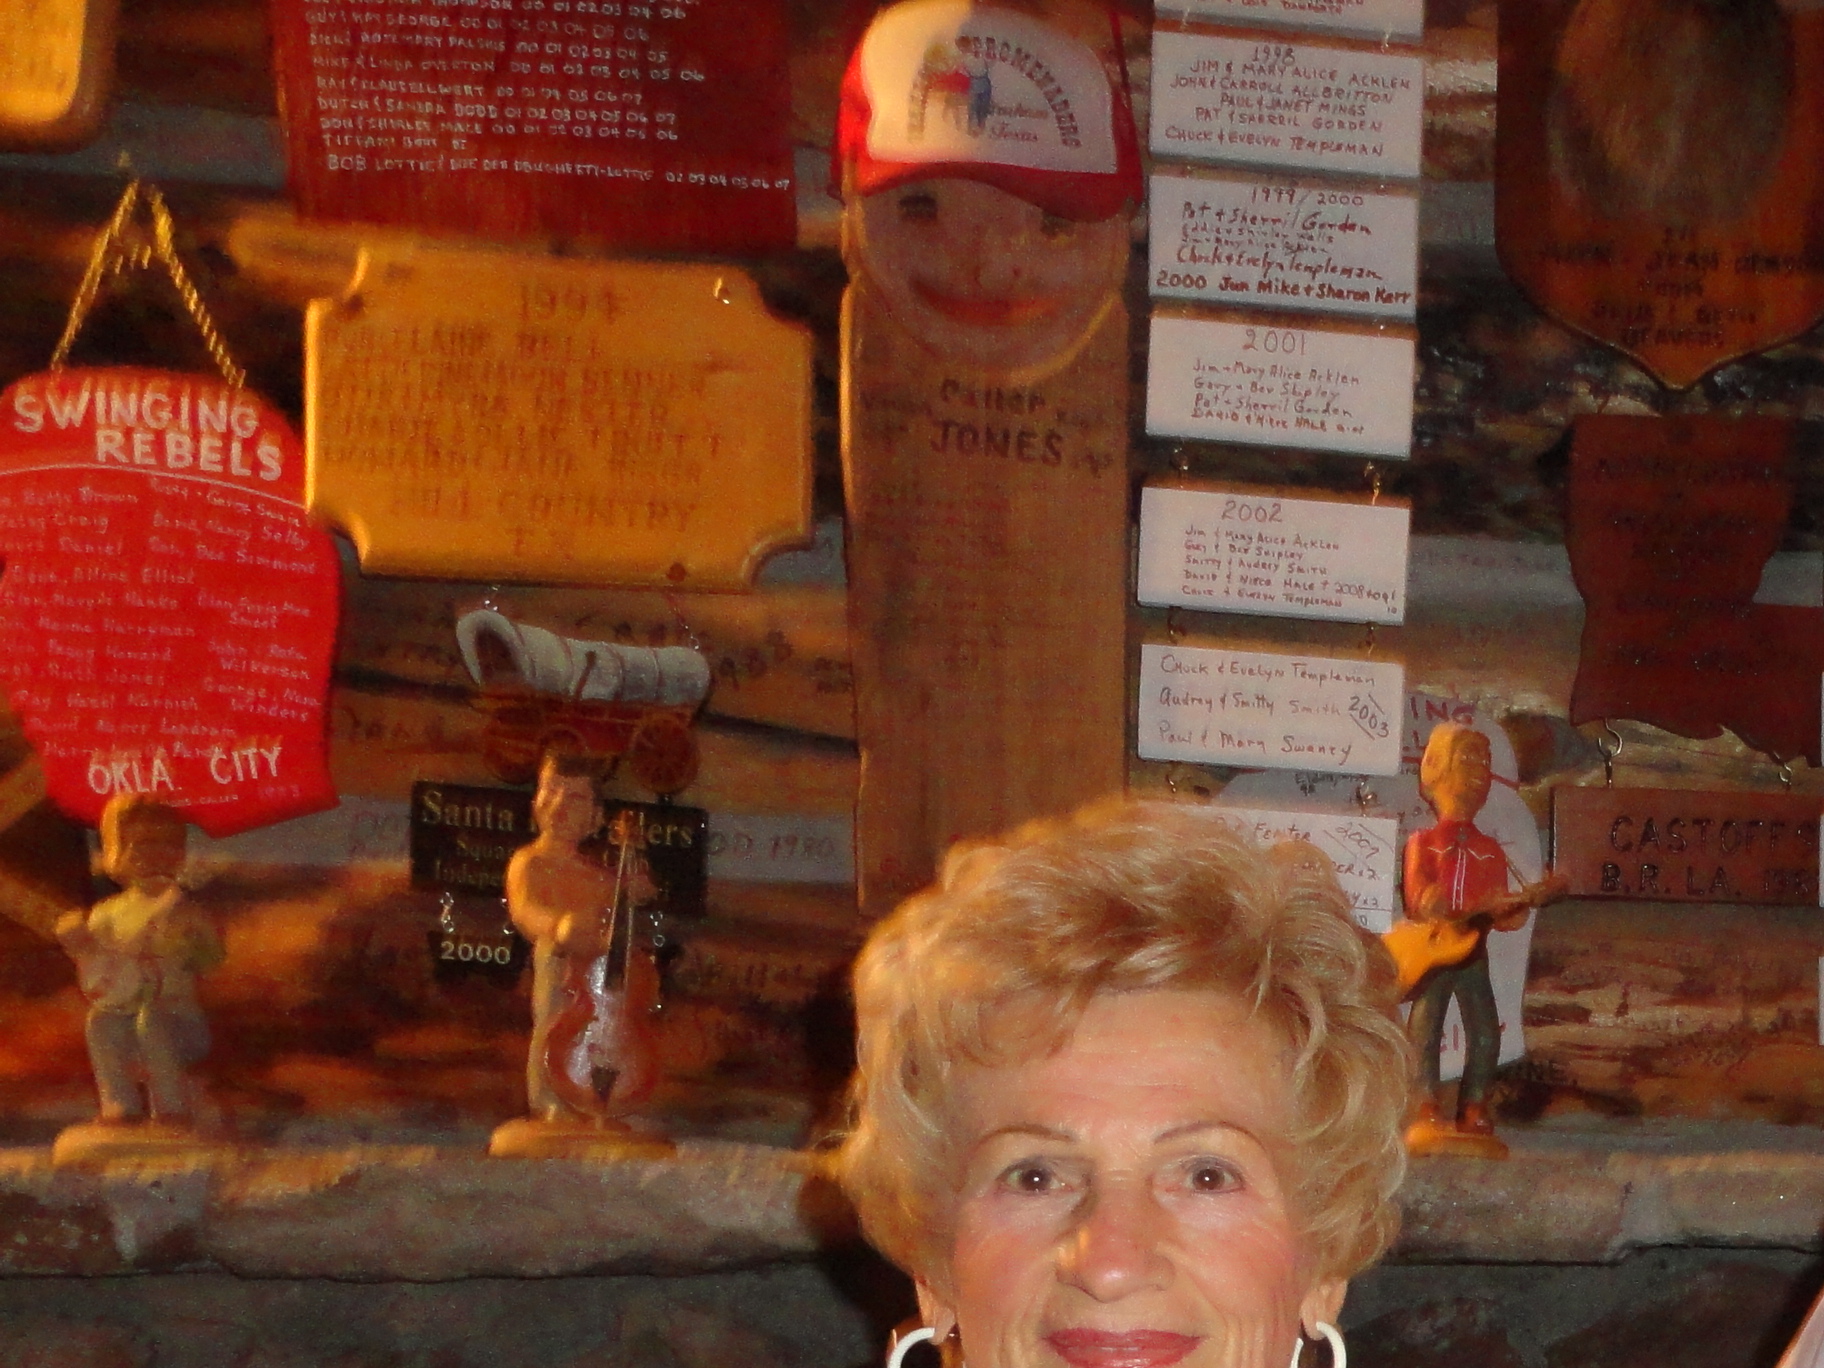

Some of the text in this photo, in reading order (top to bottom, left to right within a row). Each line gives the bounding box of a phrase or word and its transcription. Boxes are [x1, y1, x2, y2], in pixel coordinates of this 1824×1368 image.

[1252, 46, 1295, 66] 1998
[1170, 74, 1207, 89] JOHN
[1190, 59, 1219, 73] JIM
[1242, 63, 1286, 76] MARY
[1292, 66, 1338, 81] ALICE
[1349, 73, 1411, 90] ACKLEN
[1195, 106, 1221, 121] PAT
[1319, 102, 1366, 117] MINGS
[1228, 130, 1281, 147] EVELYN
[1156, 269, 1208, 290] 2000
[1257, 277, 1300, 297] Mike
[1316, 282, 1370, 301] Sharon
[1242, 328, 1306, 356] 2001
[1270, 364, 1302, 381] Alice
[13, 385, 259, 438] SWINGING
[96, 429, 282, 481] REBELS
[930, 418, 1063, 468] JONES
[1221, 500, 1284, 524] 2002
[1291, 663, 1375, 688] Templeman
[1233, 692, 1275, 716] Smitty
[1289, 700, 1340, 716] Smith
[1348, 696, 1389, 738] 2003
[1160, 720, 1192, 744] Paul
[209, 746, 283, 785] CITY
[422, 790, 515, 832] Santa
[440, 940, 511, 965] 2000
